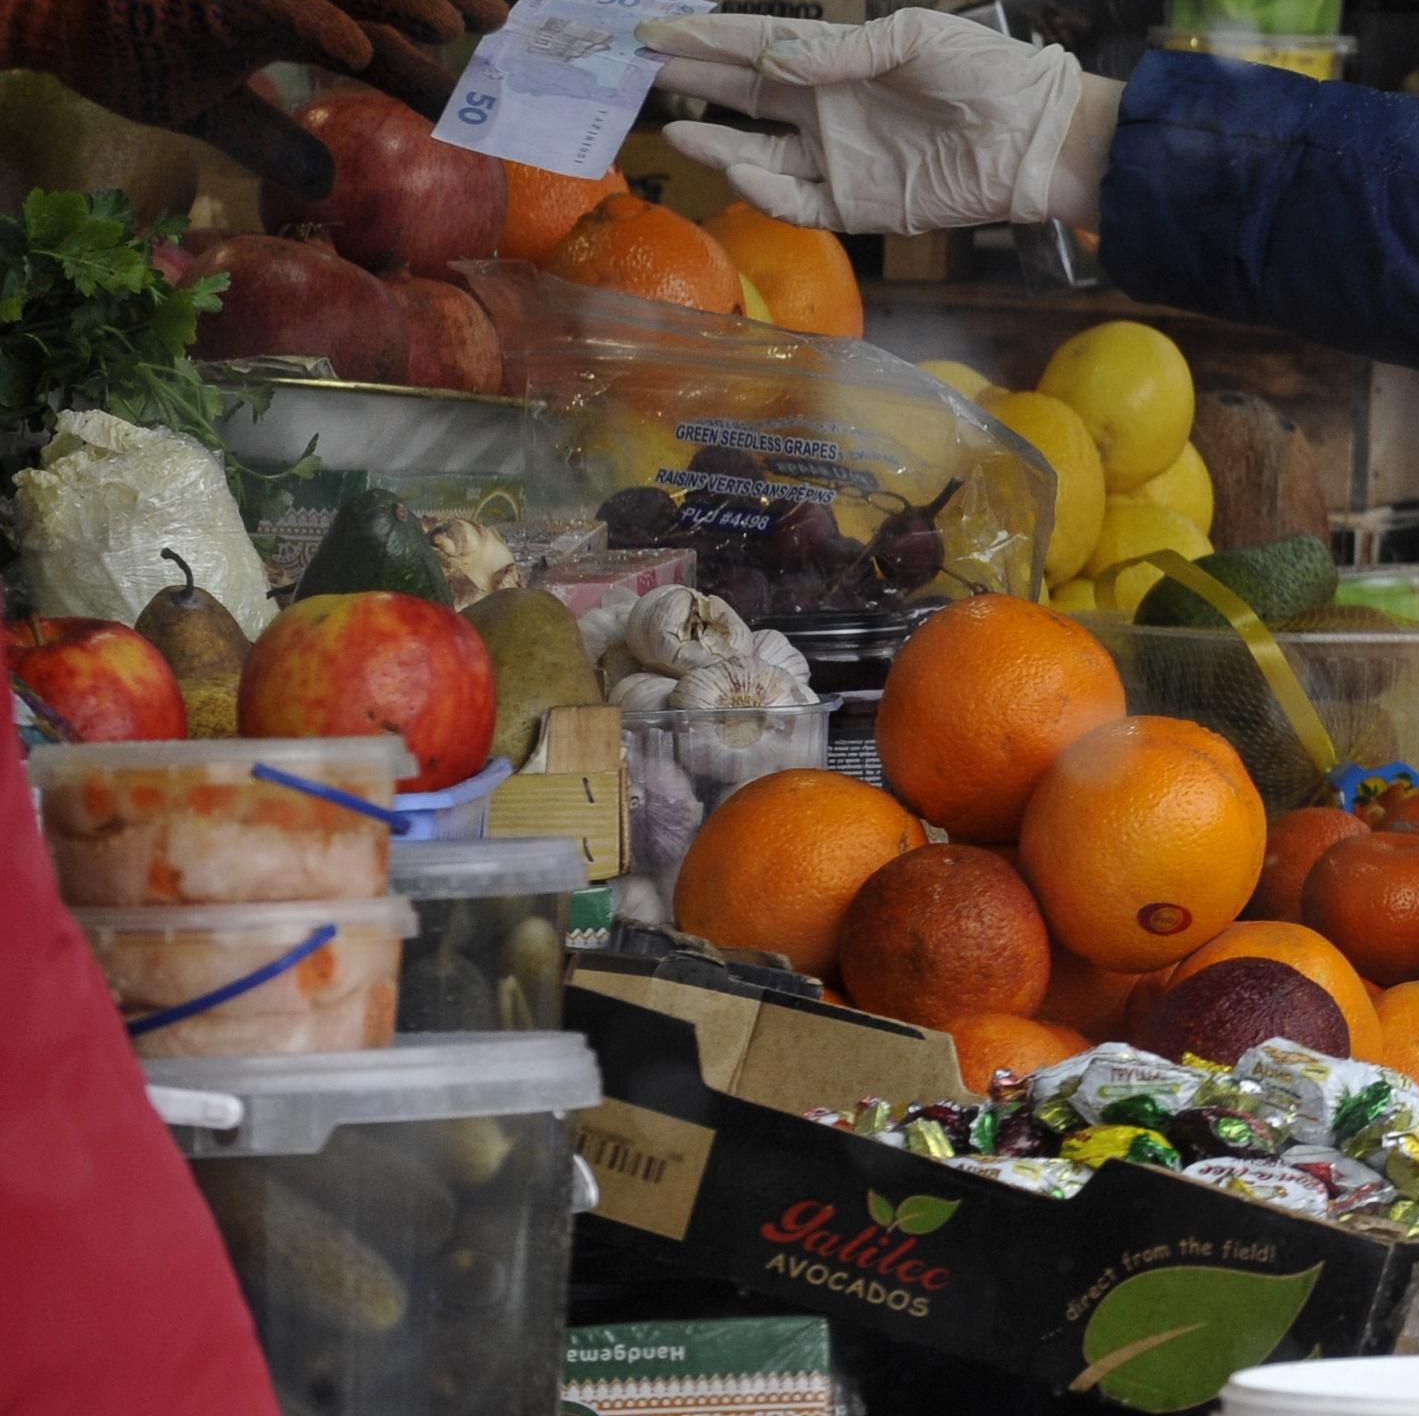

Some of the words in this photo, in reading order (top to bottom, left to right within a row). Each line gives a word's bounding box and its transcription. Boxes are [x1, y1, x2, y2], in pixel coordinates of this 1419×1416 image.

[457, 90, 497, 126] 50
[676, 424, 719, 445] GREEN
[720, 431, 783, 454] SEEDLESS
[784, 438, 838, 461] GRAPES
[656, 468, 707, 489] RAISINS
[707, 473, 752, 496] VERTS
[752, 480, 789, 500] SANS
[759, 1199, 952, 1292] Galilee
[764, 1253, 931, 1318] AVOCADOS
[1065, 1265, 1118, 1322] direct
[1122, 1243, 1171, 1273] from
[1179, 1237, 1214, 1257] the
[1221, 1239, 1277, 1264] field!
